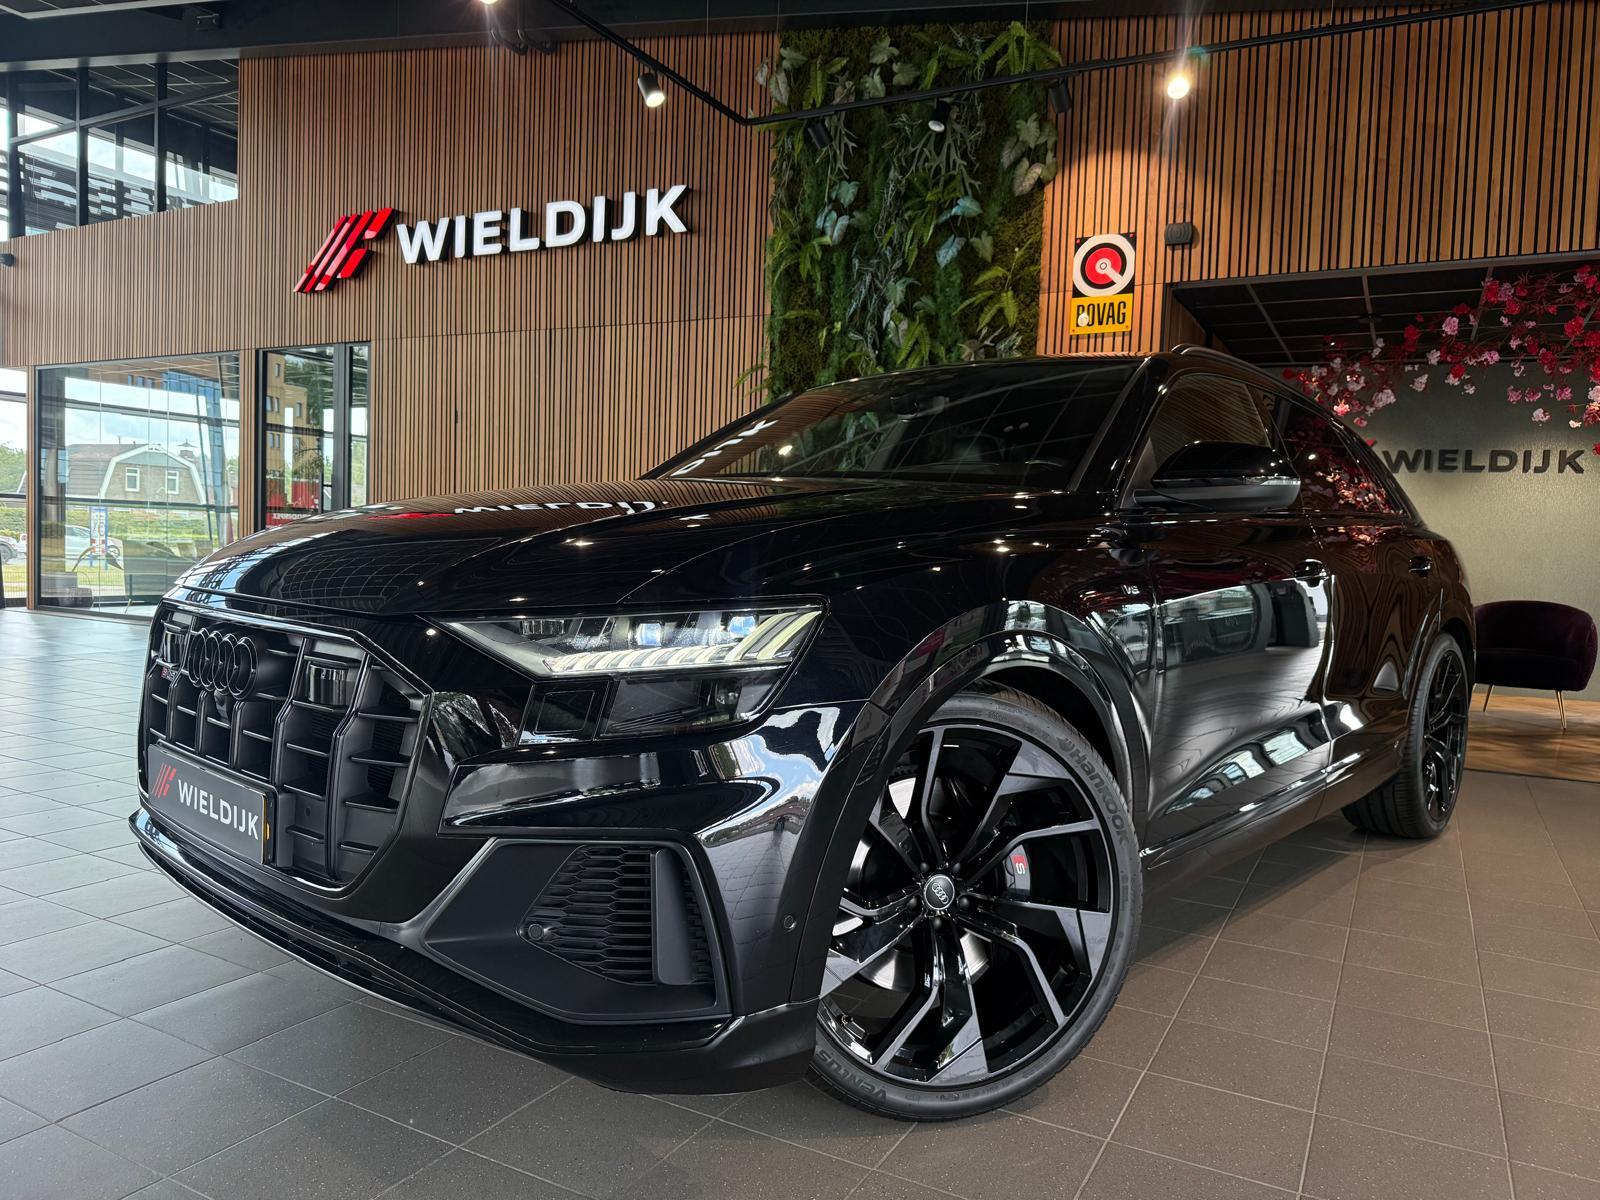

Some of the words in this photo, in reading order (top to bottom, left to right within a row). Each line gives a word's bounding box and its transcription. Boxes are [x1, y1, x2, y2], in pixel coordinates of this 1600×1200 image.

[396, 184, 688, 264] WIELDIJK
[1076, 301, 1127, 327] BOVAG
[1382, 449, 1585, 474] WIELDIJK
[177, 779, 259, 841] WIELDIJK
[1069, 748, 1131, 845] Hankook
